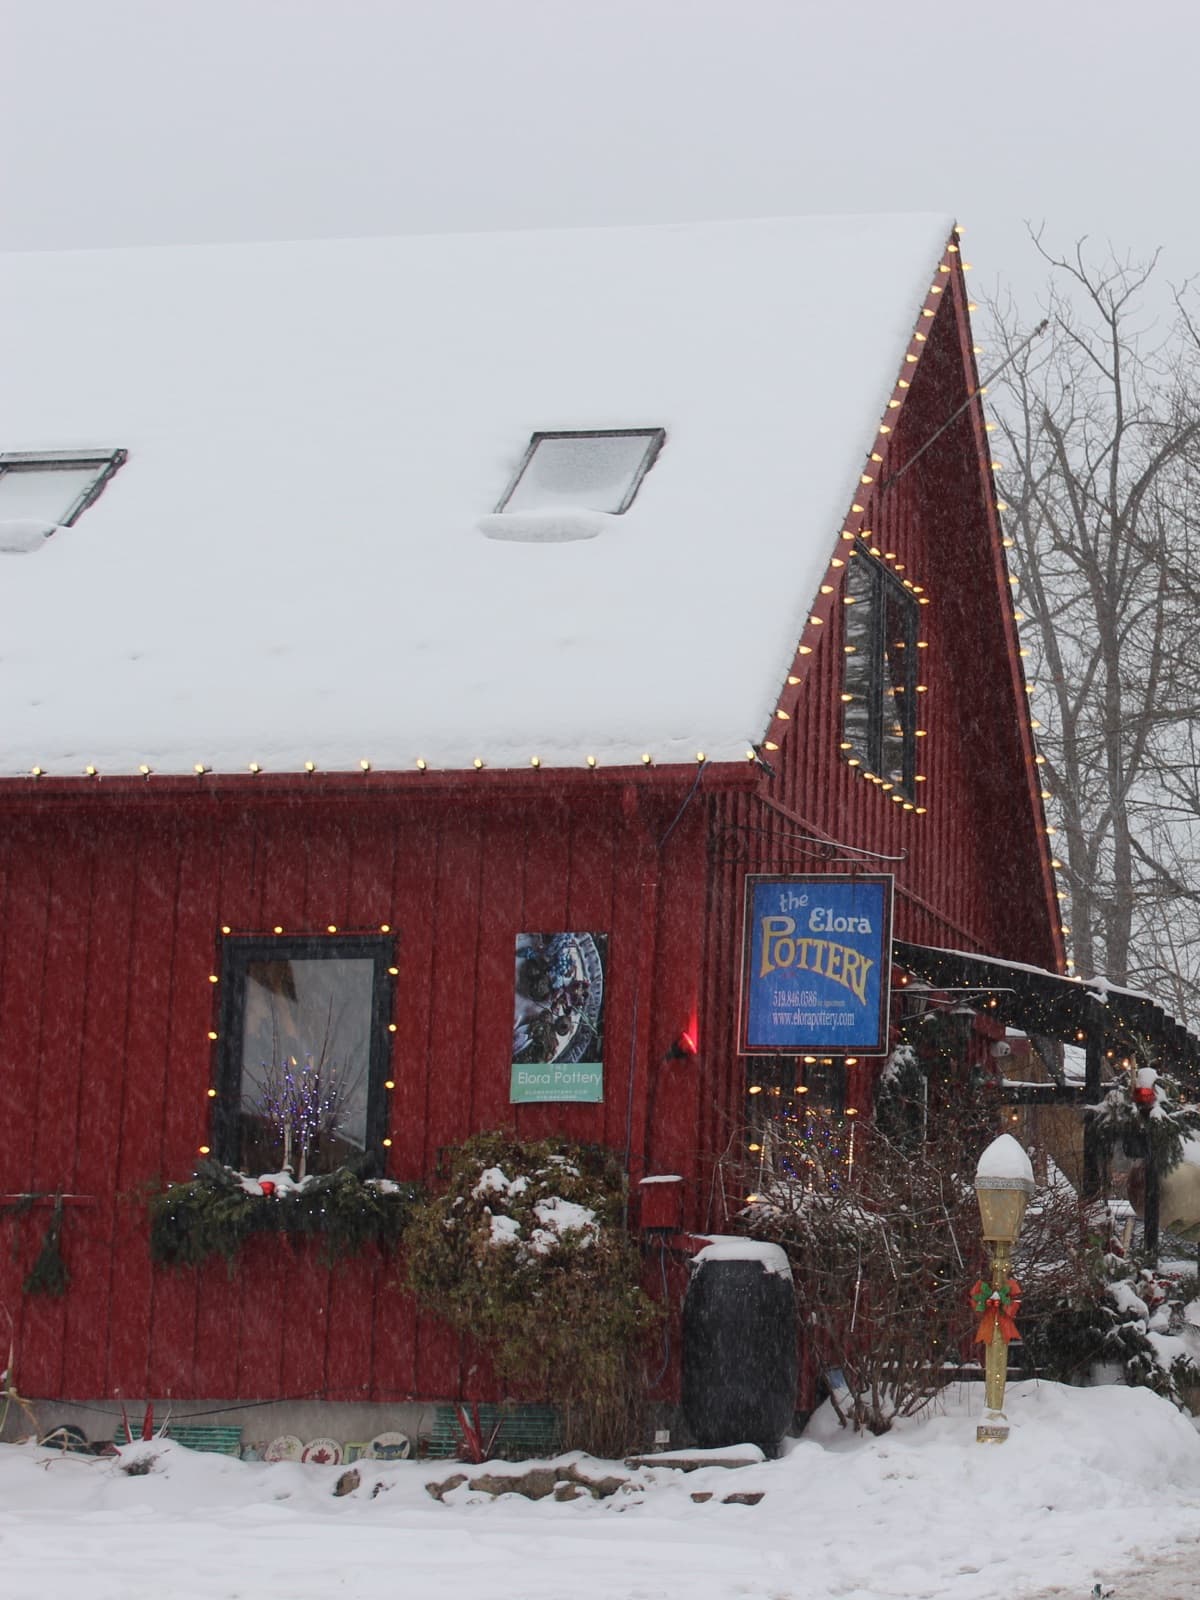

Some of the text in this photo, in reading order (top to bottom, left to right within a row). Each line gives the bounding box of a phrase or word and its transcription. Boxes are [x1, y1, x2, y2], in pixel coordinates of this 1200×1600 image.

[779, 891, 809, 912] the
[808, 907, 872, 934] Elora
[760, 916, 874, 1006] POTTERY
[772, 1008, 855, 1031] www.elorapottery.com
[518, 1071, 602, 1086] Elora Pottery
